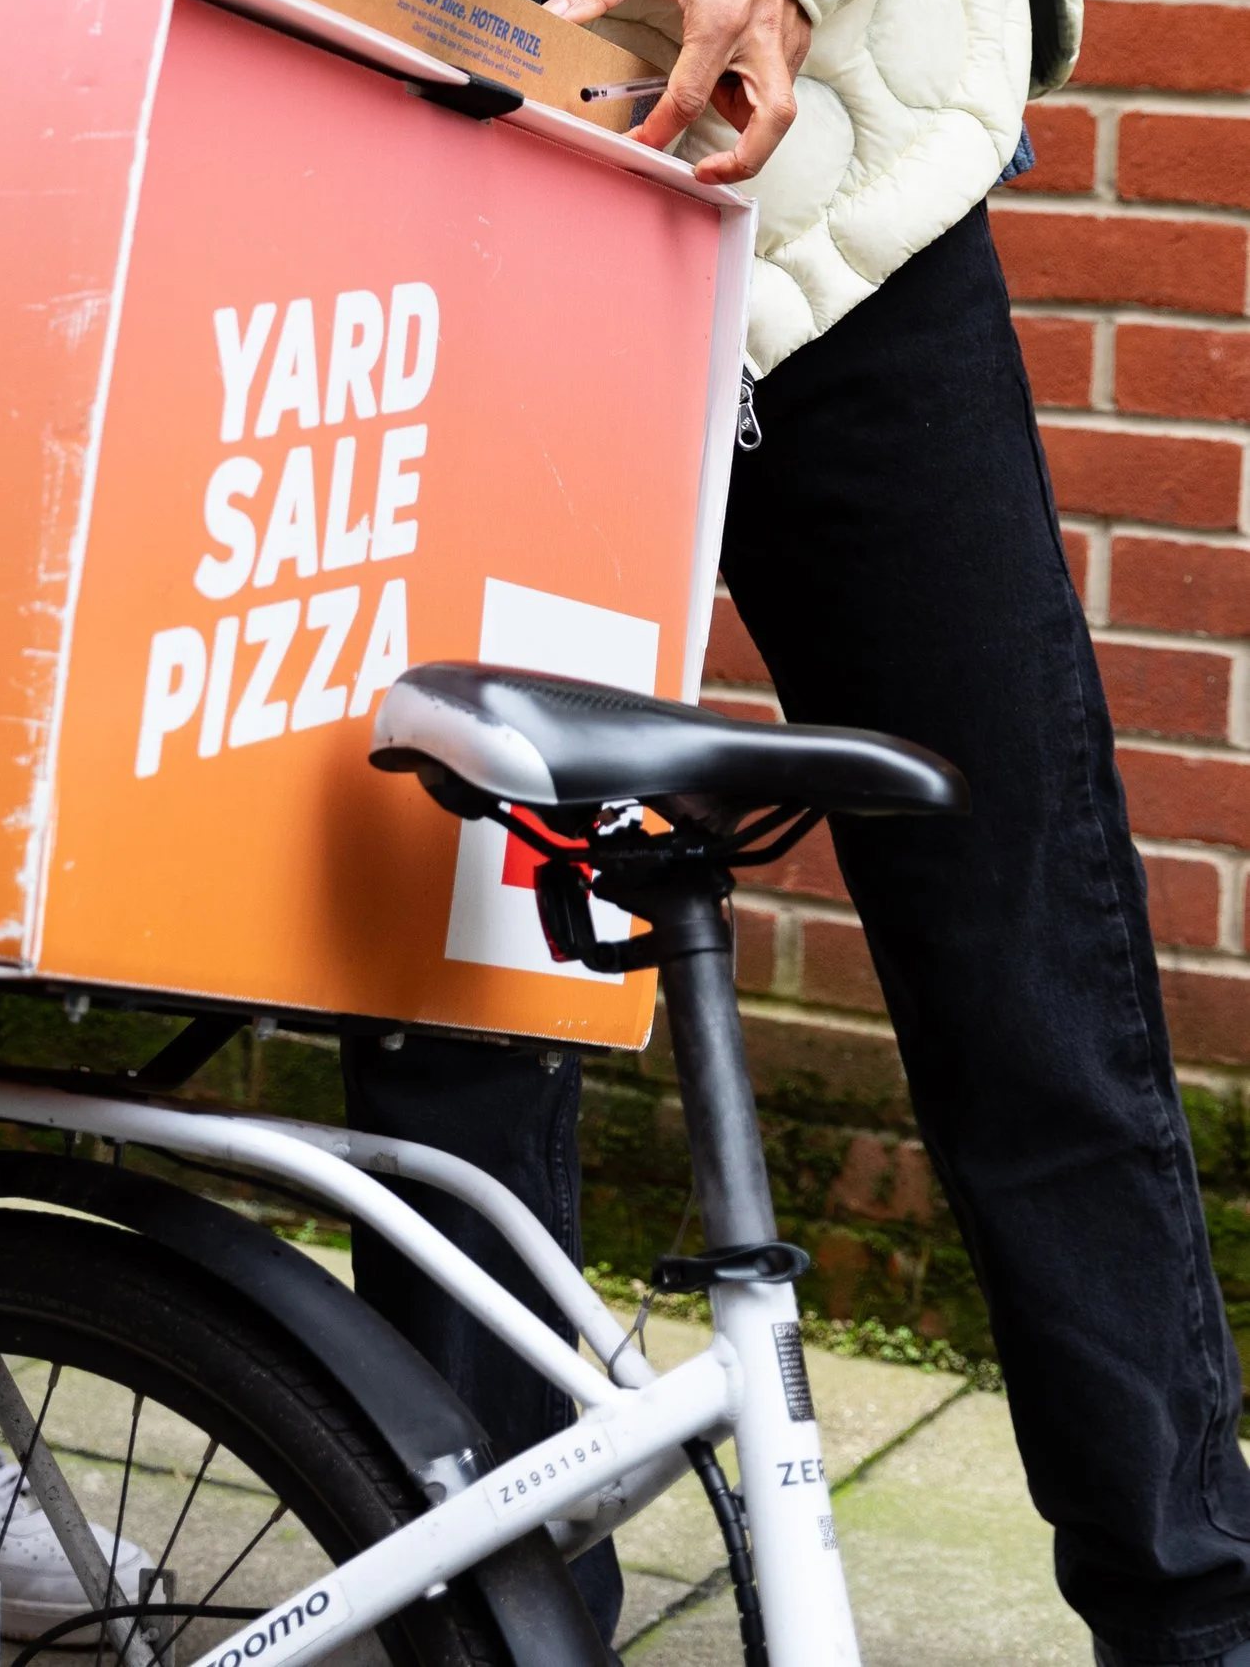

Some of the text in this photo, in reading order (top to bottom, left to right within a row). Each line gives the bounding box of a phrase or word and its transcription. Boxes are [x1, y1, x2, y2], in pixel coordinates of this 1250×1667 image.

[468, 5, 511, 41] HOTTER
[213, 282, 440, 443] YARD
[193, 424, 428, 600] SALE
[134, 578, 411, 779] PIZZA
[498, 1439, 602, 1504] Z893194
[206, 1590, 331, 1667] oomo
